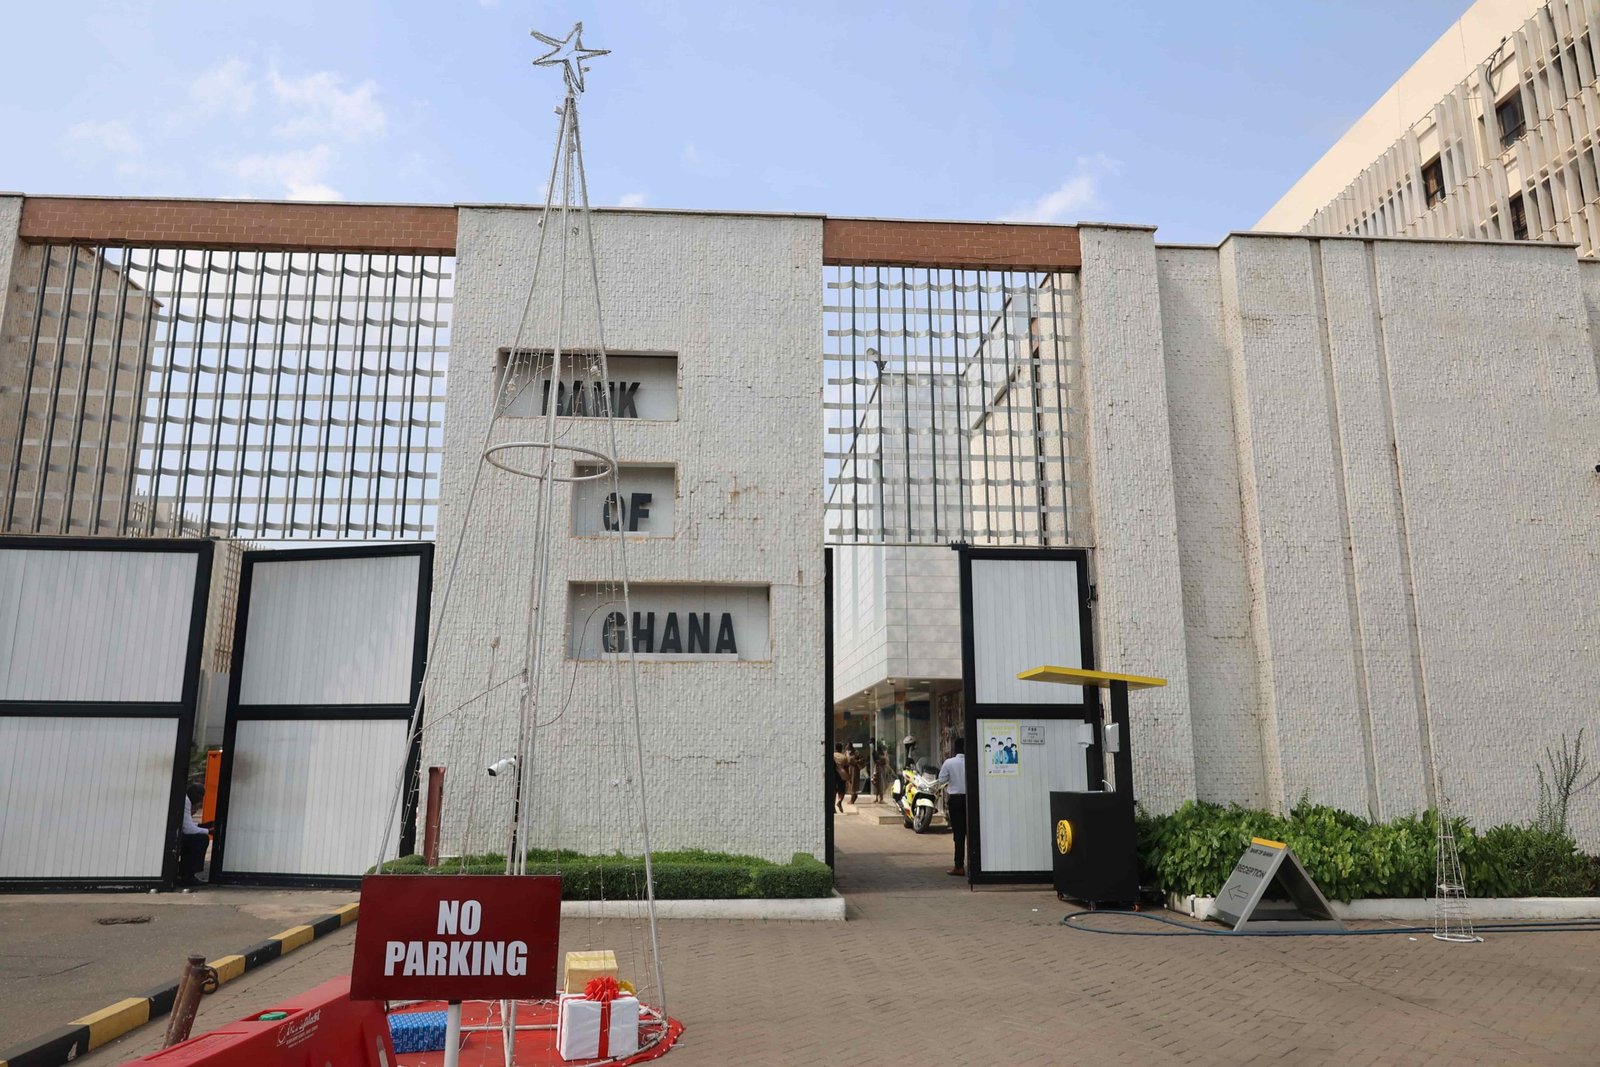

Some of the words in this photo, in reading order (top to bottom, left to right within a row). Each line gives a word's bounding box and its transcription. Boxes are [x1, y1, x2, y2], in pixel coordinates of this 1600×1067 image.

[541, 380, 640, 418] BANK
[603, 492, 653, 532] OF
[602, 611, 738, 654] GHANA
[1237, 864, 1267, 879] RECEPTION
[437, 900, 482, 936] NO
[384, 940, 528, 976] PARKING
